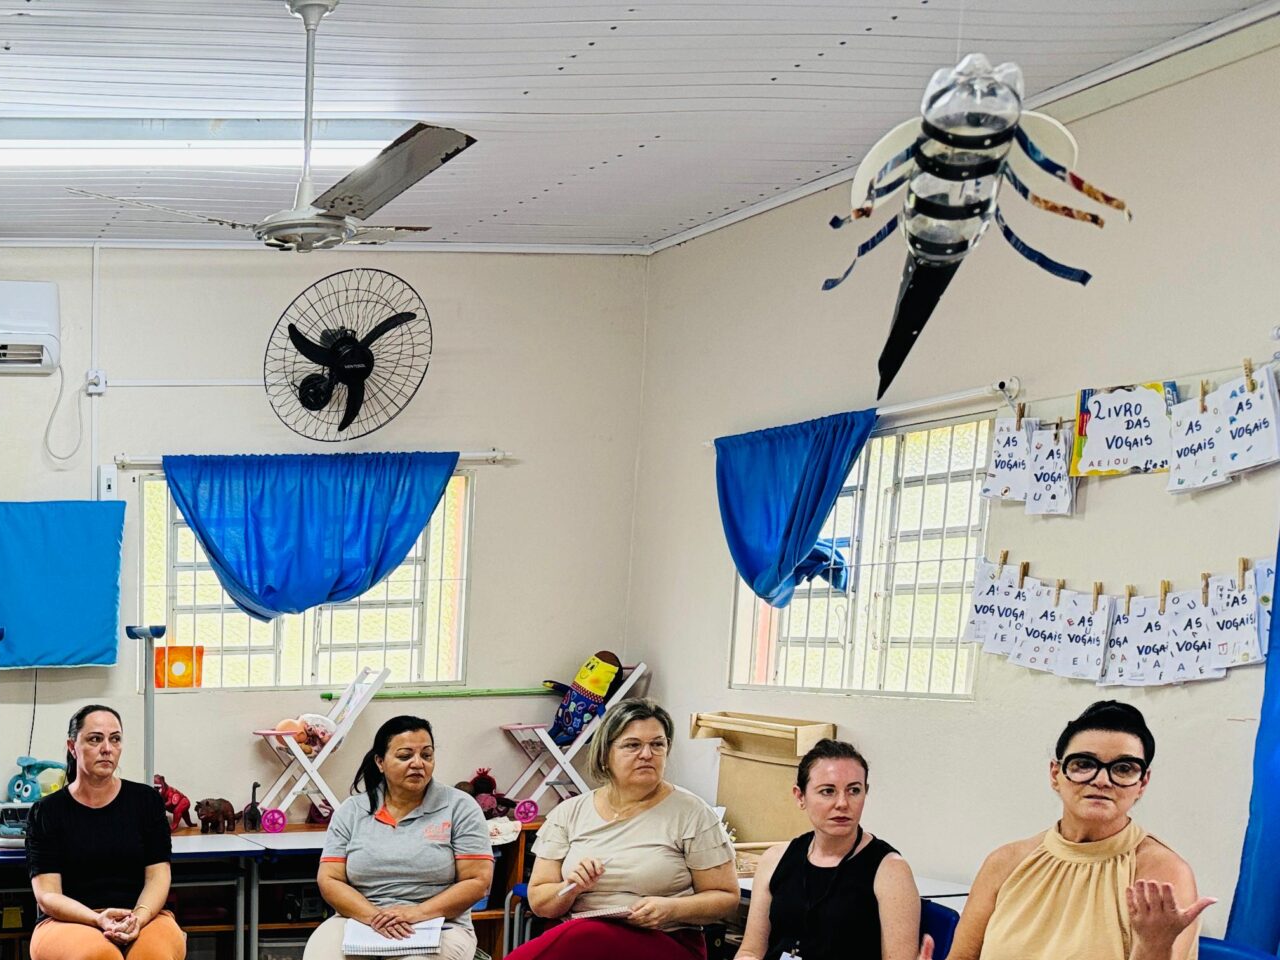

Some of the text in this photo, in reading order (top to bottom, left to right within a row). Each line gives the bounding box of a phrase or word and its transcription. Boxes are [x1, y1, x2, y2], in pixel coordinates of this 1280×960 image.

[1235, 399, 1253, 415] AS
[1125, 417, 1150, 430] DAS
[1185, 420, 1202, 436] AS
[1003, 436, 1018, 448] AS
[1105, 435, 1152, 450] VOGAIS
[1046, 449, 1061, 460] AS
[1014, 591, 1027, 601] AS
[1231, 594, 1247, 607] AS
[1039, 610, 1055, 621] AS
[1077, 616, 1093, 627] AS
[1115, 615, 1129, 625] AS
[1144, 621, 1161, 633] AS
[1183, 617, 1202, 631] AS
